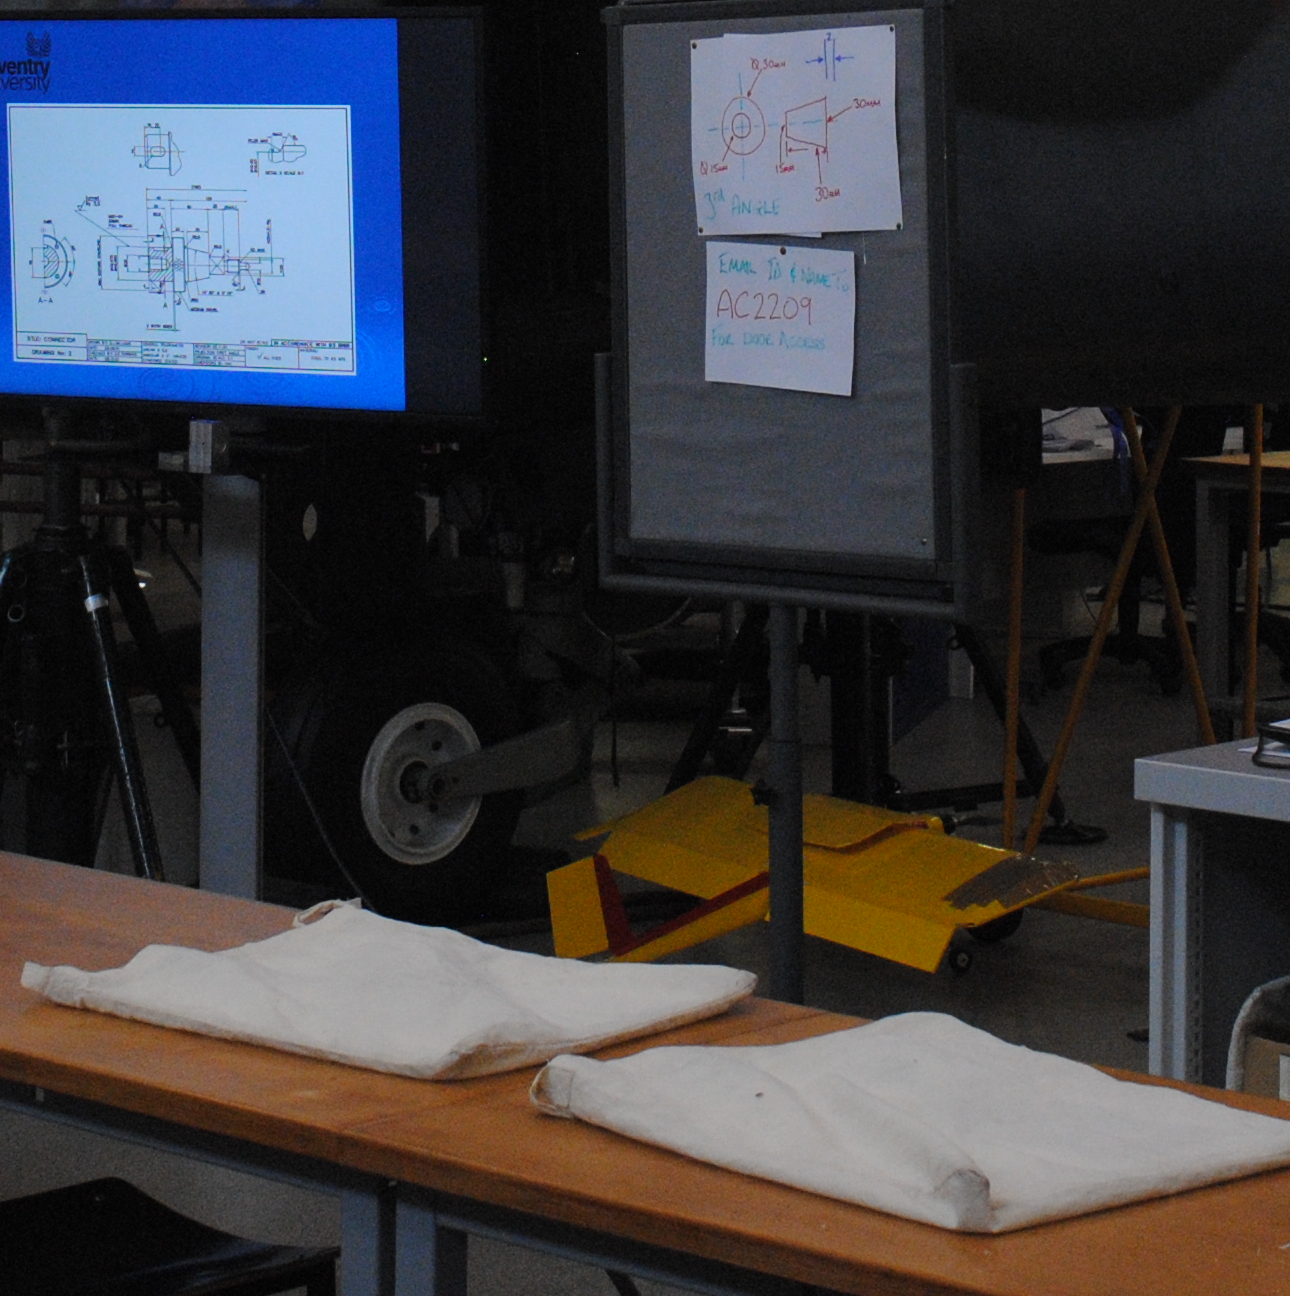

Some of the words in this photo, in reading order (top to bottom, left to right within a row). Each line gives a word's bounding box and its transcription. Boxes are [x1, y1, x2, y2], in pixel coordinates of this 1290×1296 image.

[704, 188, 725, 220] 3rd
[718, 252, 757, 275] EMAIL
[767, 257, 782, 281] ID
[716, 288, 812, 326] AC2209
